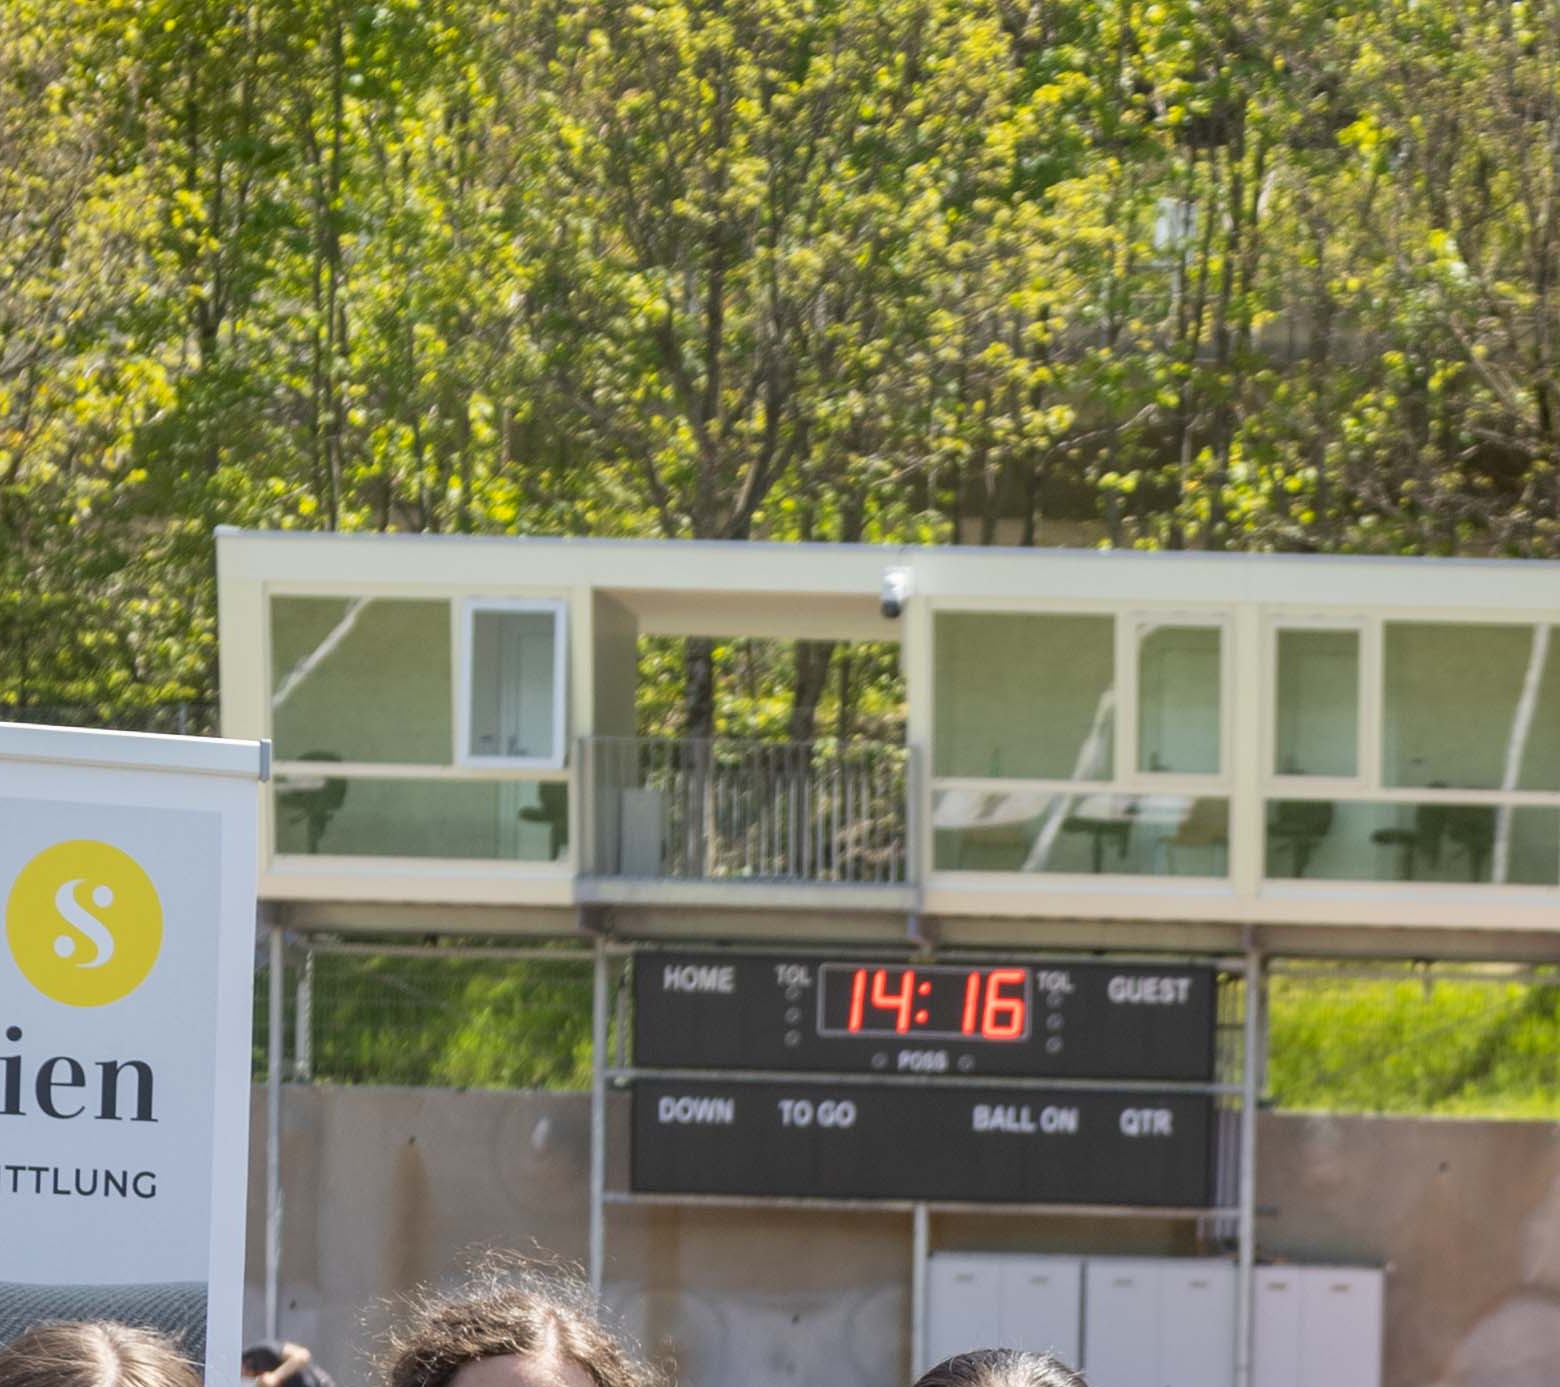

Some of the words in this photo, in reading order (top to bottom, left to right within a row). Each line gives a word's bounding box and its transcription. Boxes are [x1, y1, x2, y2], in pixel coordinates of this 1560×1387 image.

[663, 964, 735, 993] HOME
[776, 964, 811, 986] TOL
[1038, 971, 1074, 993] TOL
[848, 968, 1028, 1040] 14:16
[1107, 977, 1192, 1004] GUEST
[658, 1097, 735, 1125] DOWN
[778, 1100, 814, 1126] TO
[816, 1101, 857, 1128] GO
[971, 1105, 1035, 1133] BALL
[1039, 1107, 1078, 1134] ON
[1119, 1108, 1173, 1136] QTR
